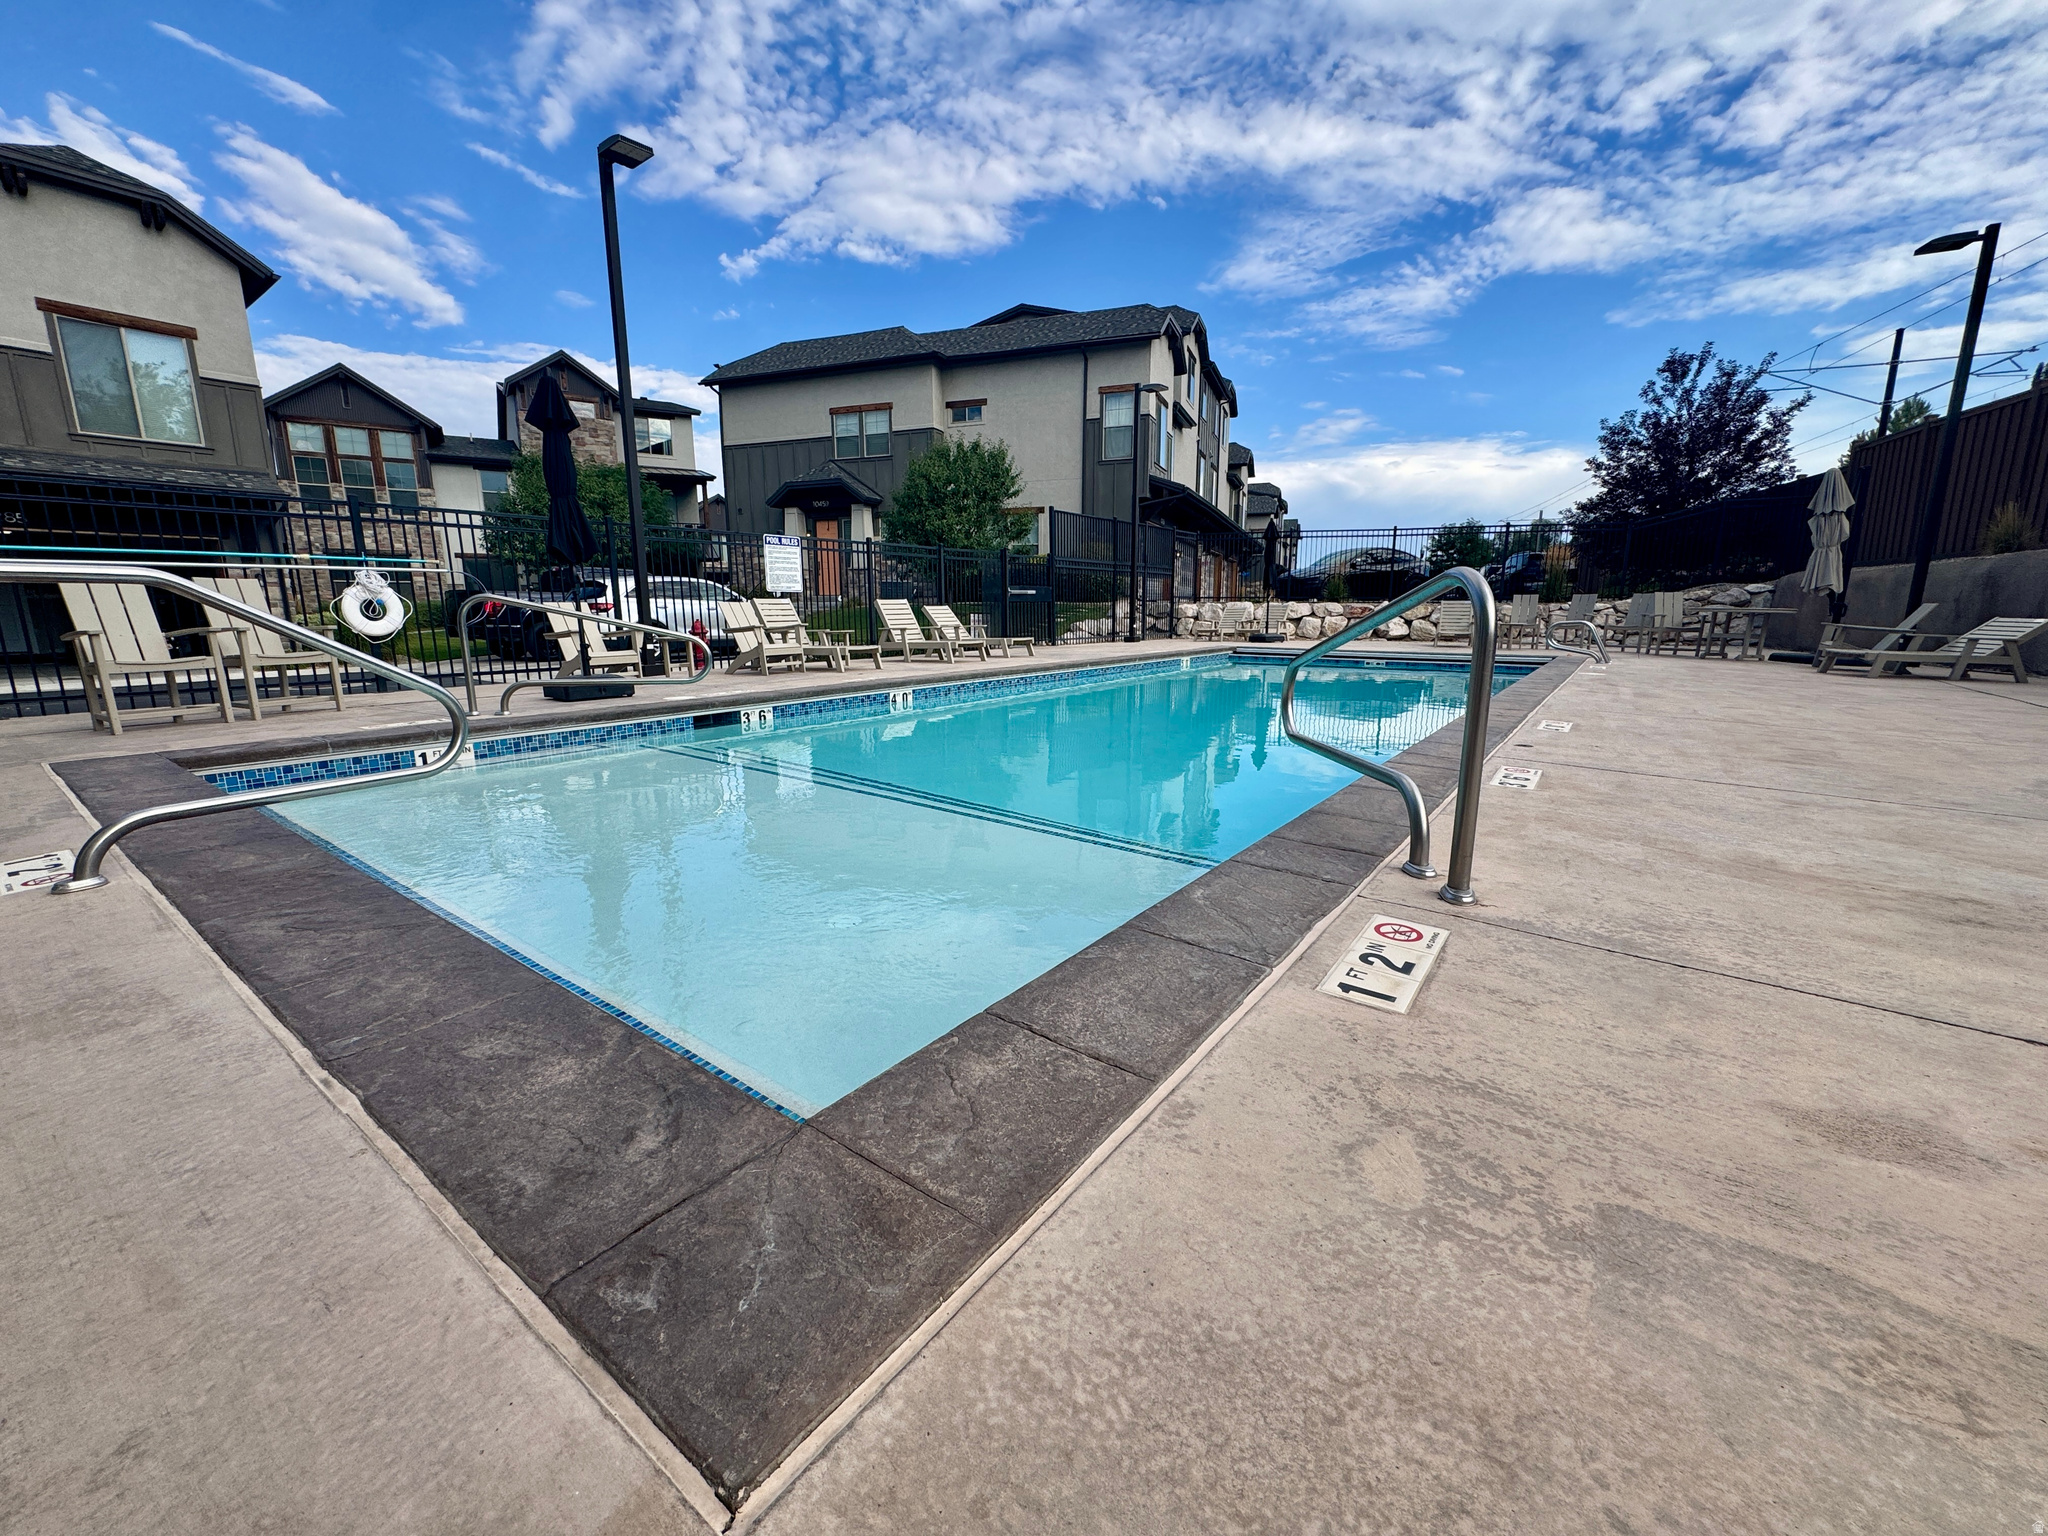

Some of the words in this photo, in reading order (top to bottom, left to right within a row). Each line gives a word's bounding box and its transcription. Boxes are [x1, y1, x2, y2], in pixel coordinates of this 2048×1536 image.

[0, 511, 27, 524] 85
[766, 536, 781, 545] POOL
[781, 538, 799, 546] RULES
[742, 711, 751, 723] 3
[418, 751, 429, 766] 1
[7, 862, 64, 877] 2
[1364, 941, 1387, 954] IN
[1358, 952, 1417, 976] 2
[1345, 966, 1369, 981] FT
[1337, 981, 1398, 1003] 1
